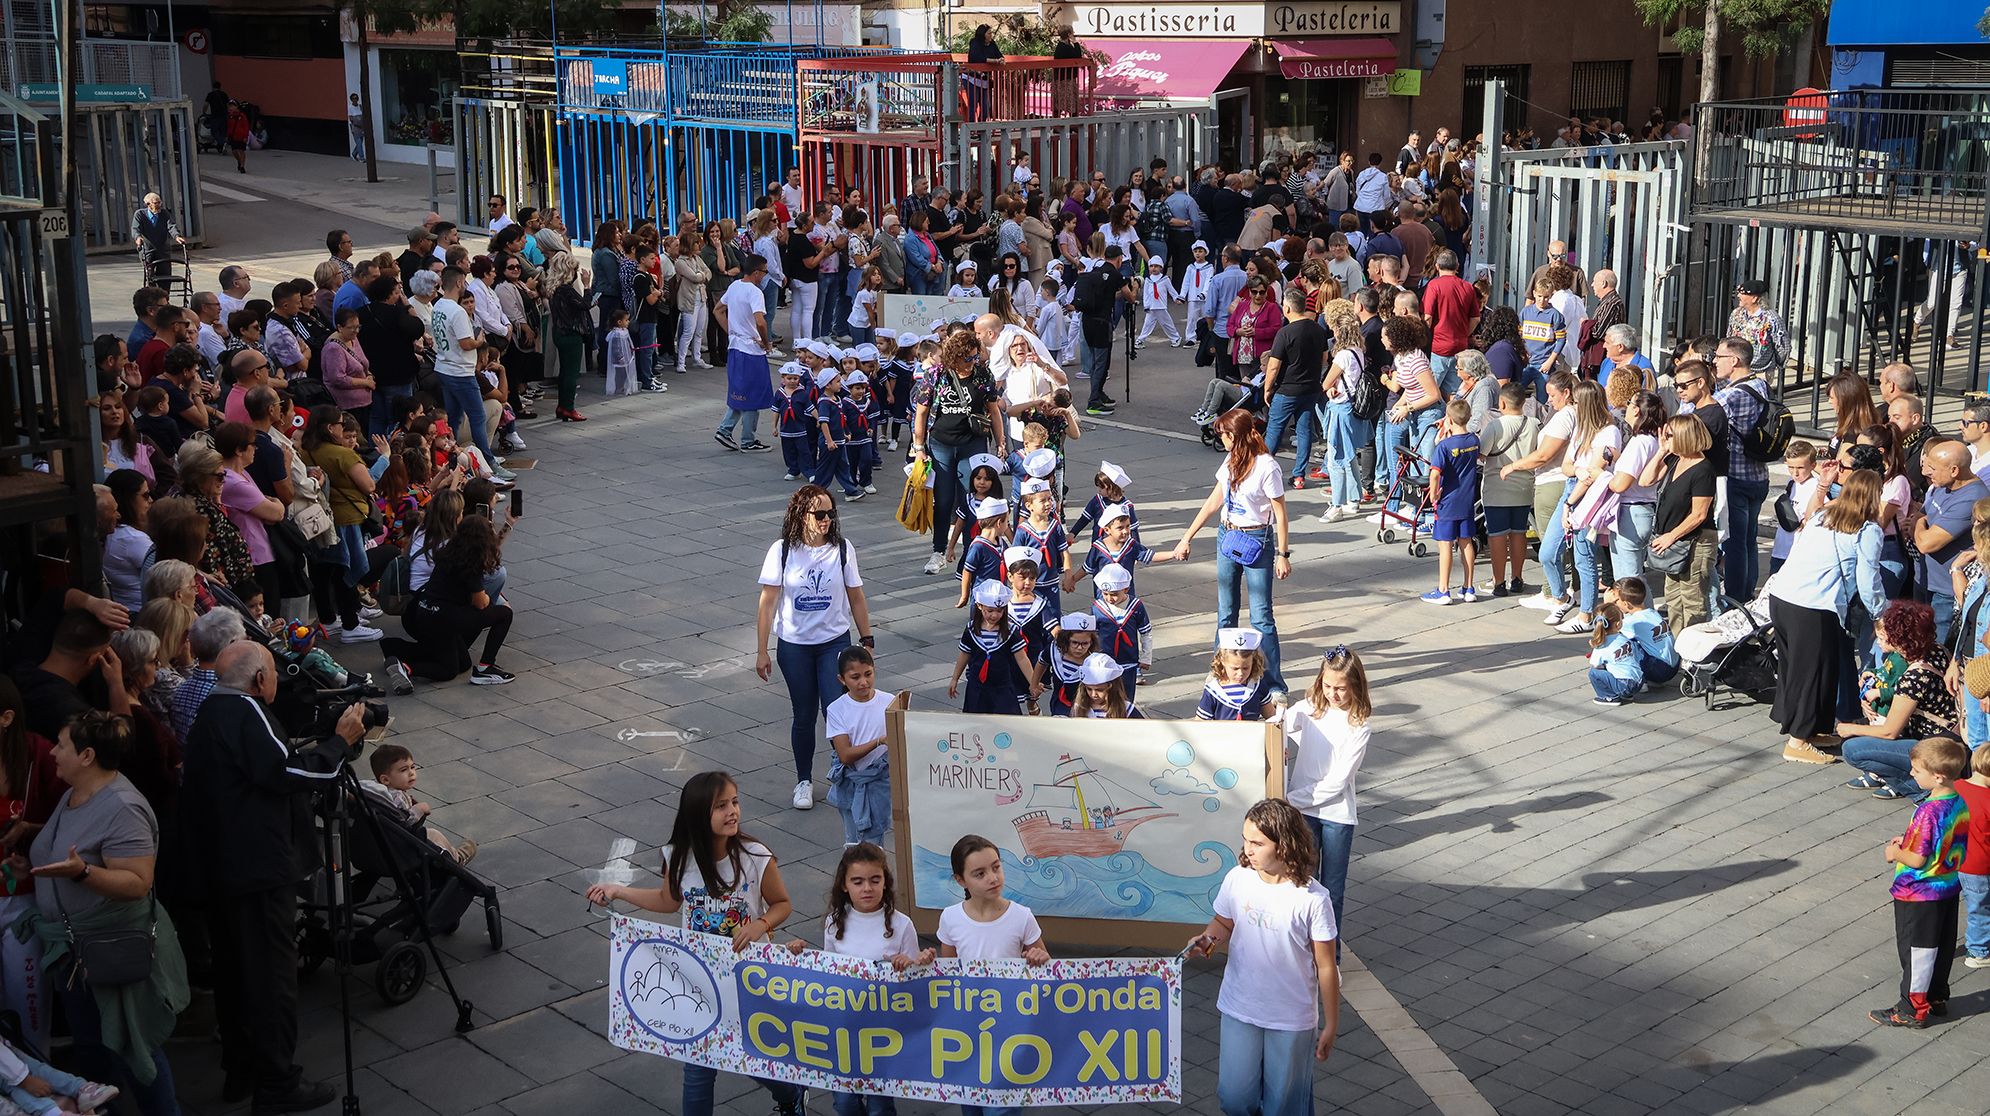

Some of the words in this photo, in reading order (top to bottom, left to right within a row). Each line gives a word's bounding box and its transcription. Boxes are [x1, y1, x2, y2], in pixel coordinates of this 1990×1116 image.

[1087, 7, 1236, 33] Pastisseria
[1274, 4, 1391, 33] Pasteleria
[1299, 58, 1378, 76] Pasteleria
[1524, 325, 1547, 338] LEVI'S
[949, 731, 985, 764] ELS
[929, 763, 1024, 806] MARINERS
[653, 944, 679, 957] AMPA
[741, 965, 914, 1013] Cercavila
[928, 979, 1003, 1013] Fira
[1016, 981, 1161, 1015] d'Onda
[747, 1011, 904, 1076] CEIP
[930, 1016, 1053, 1085] PÍO
[1077, 1028, 1162, 1083] XII
